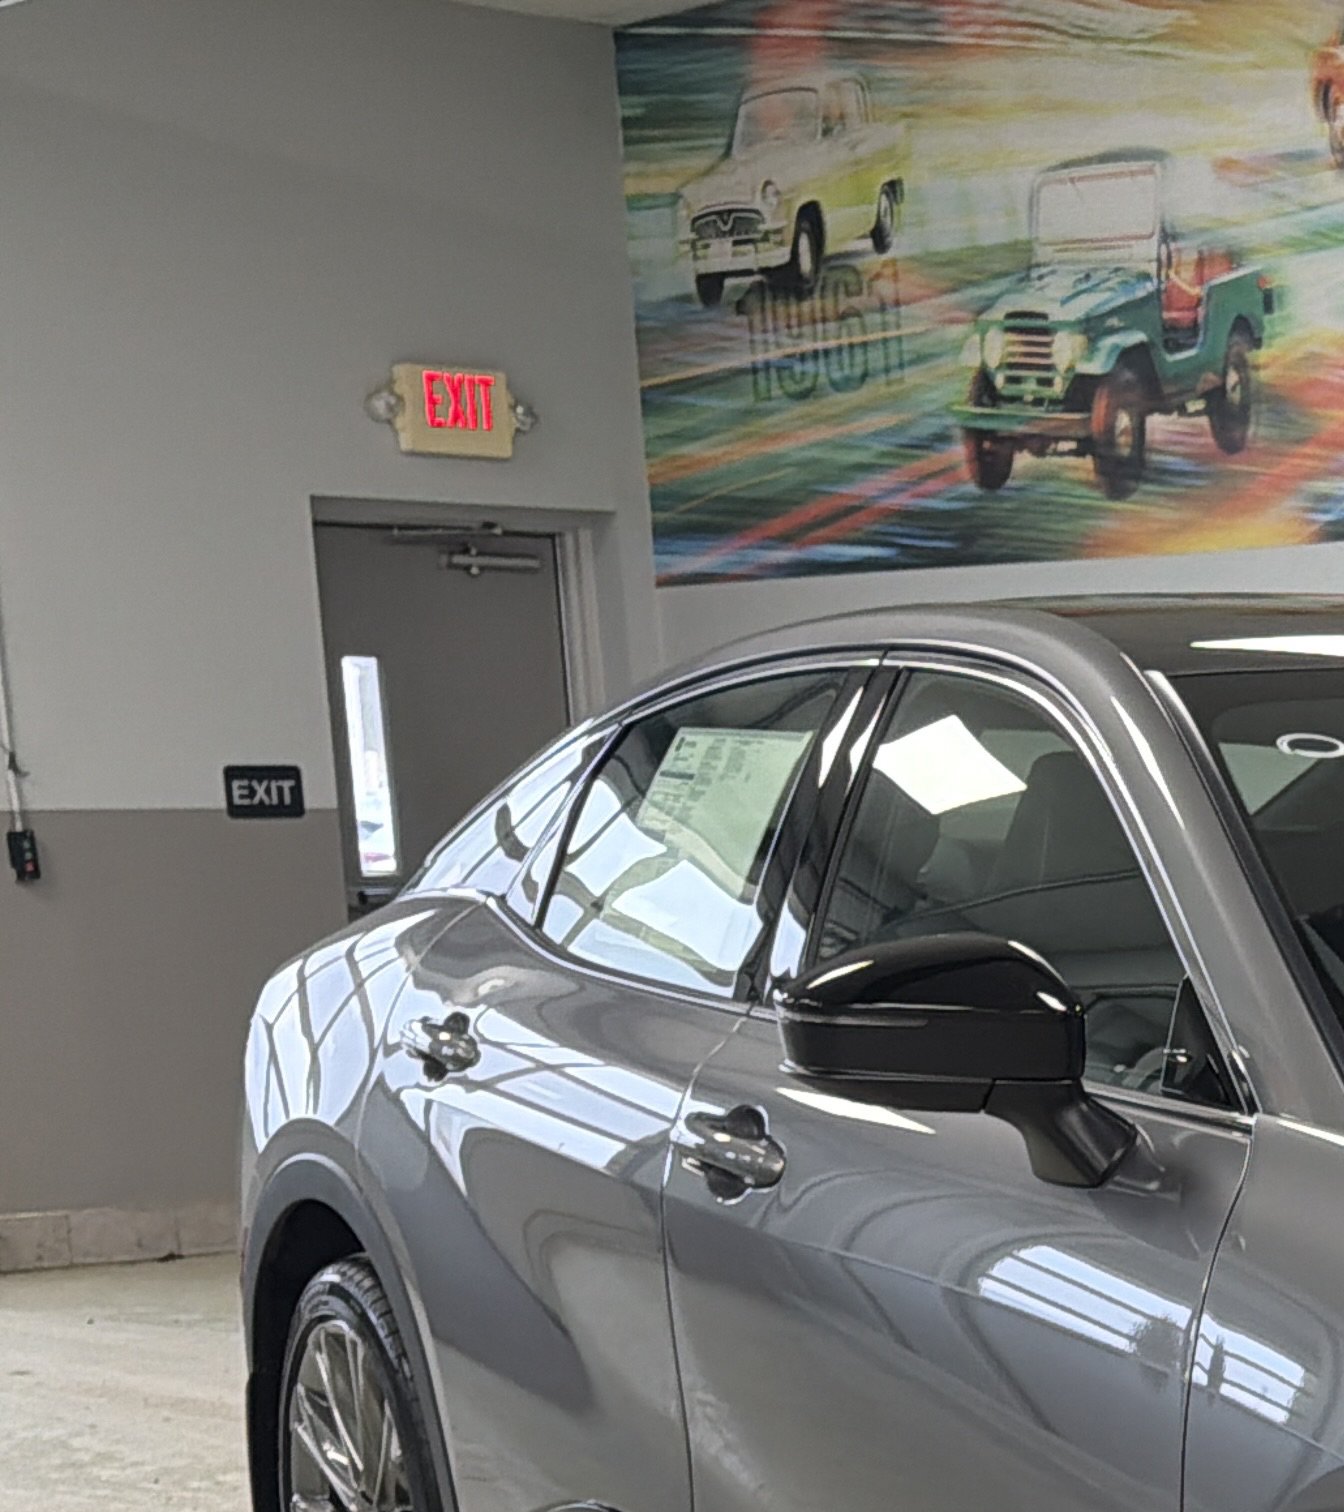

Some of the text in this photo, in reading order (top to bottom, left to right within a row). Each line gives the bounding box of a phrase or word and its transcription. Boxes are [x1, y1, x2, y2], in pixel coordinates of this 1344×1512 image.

[736, 259, 904, 402] 1961
[422, 369, 495, 432] EXIT
[231, 778, 296, 806] EXIT
